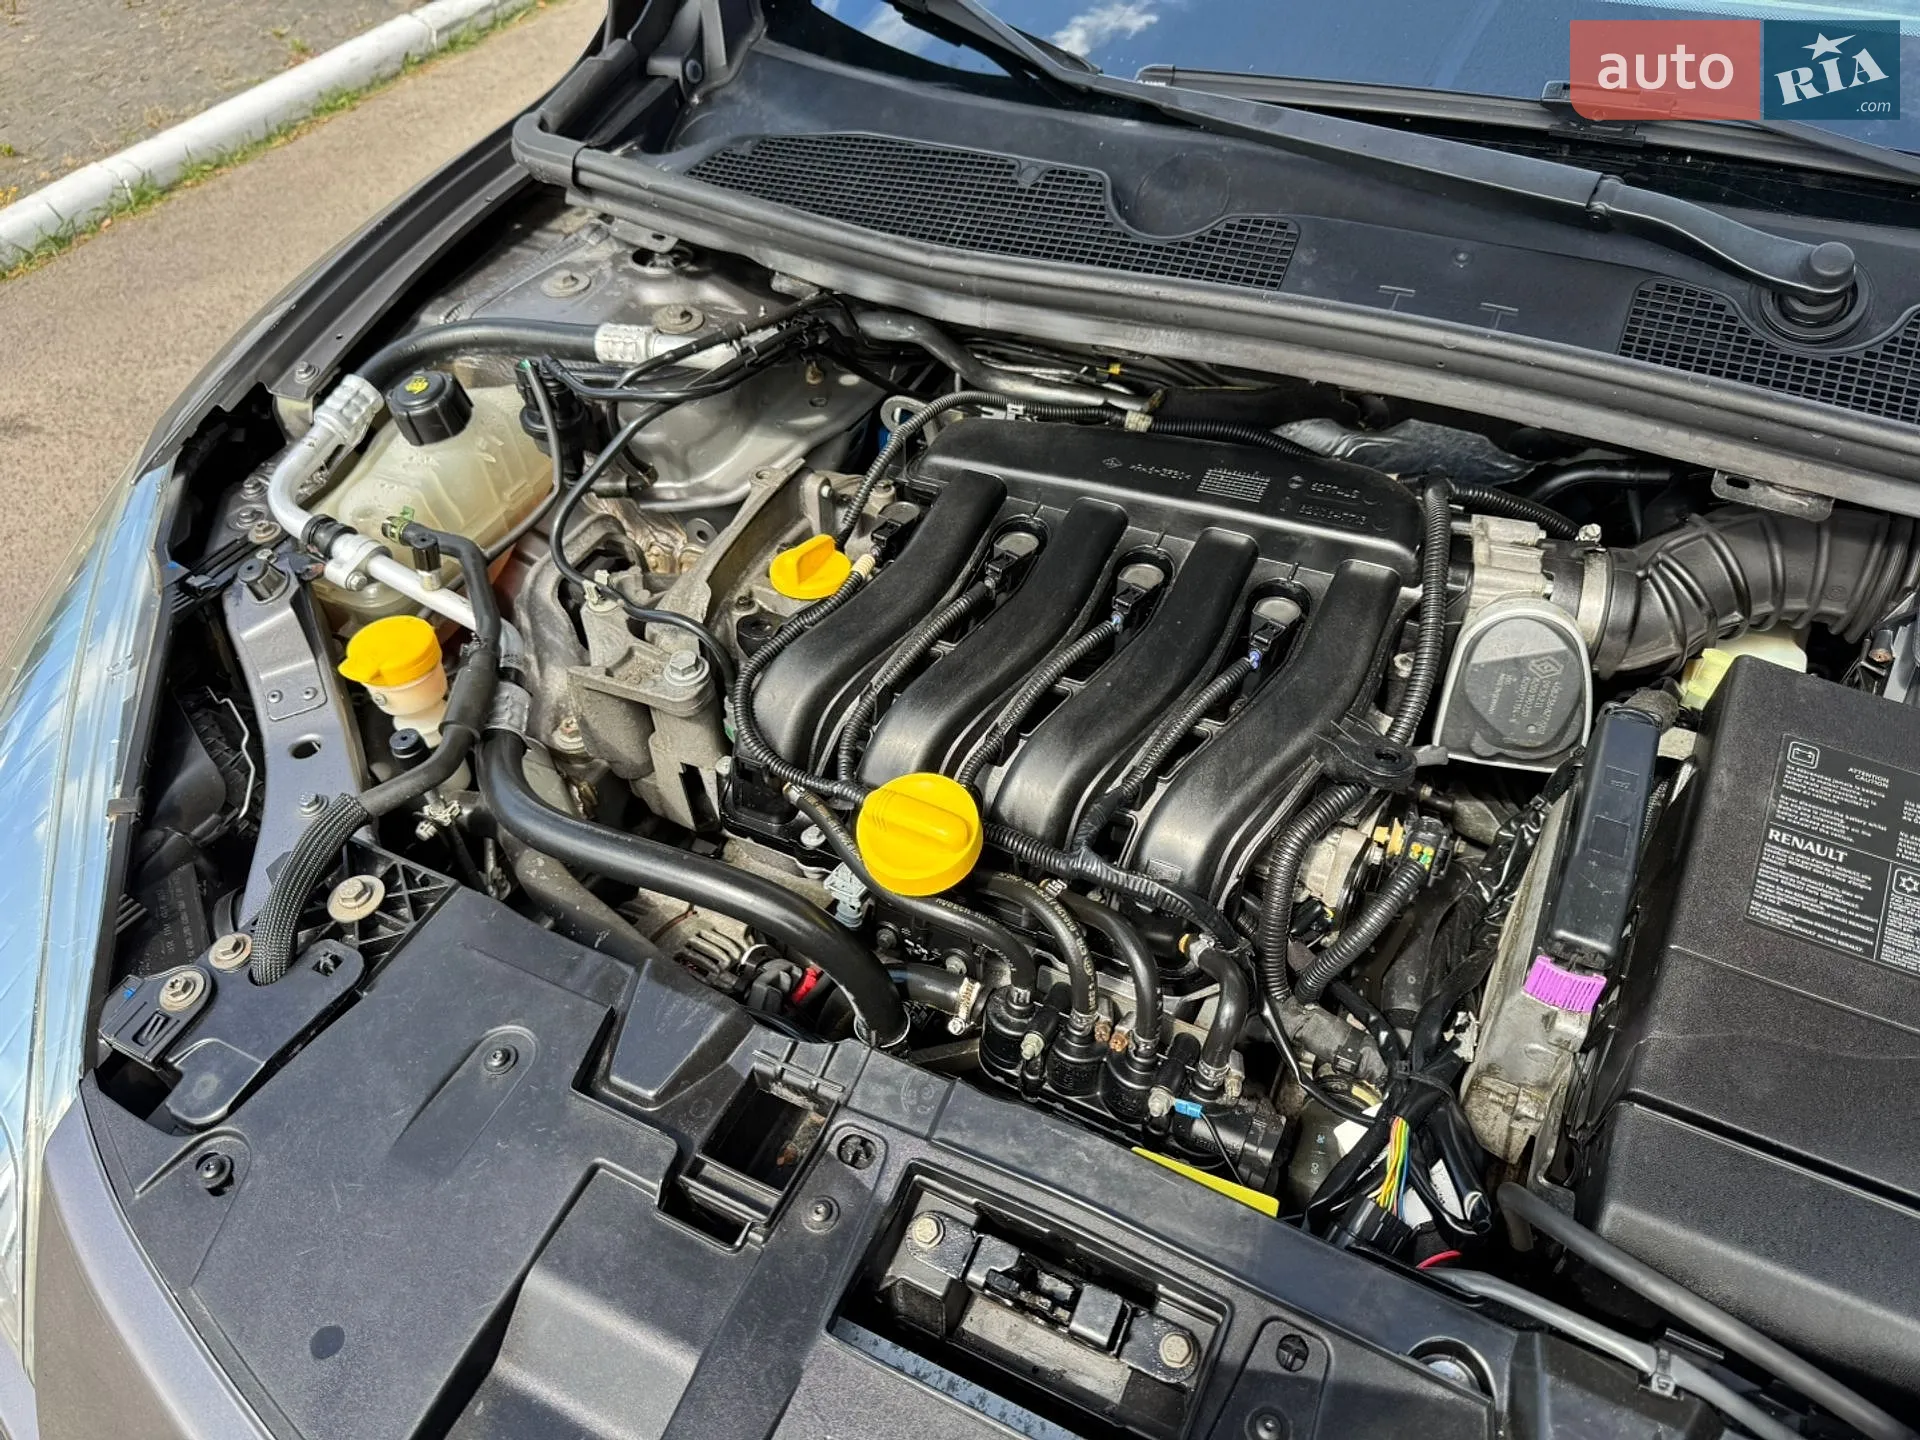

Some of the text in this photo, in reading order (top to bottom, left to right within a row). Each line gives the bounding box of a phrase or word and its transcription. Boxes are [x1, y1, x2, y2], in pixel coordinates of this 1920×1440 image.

[1847, 767, 1889, 783] ATTENTION
[1854, 774, 1889, 789] CAUTION
[1767, 827, 1848, 863] RENAULT
